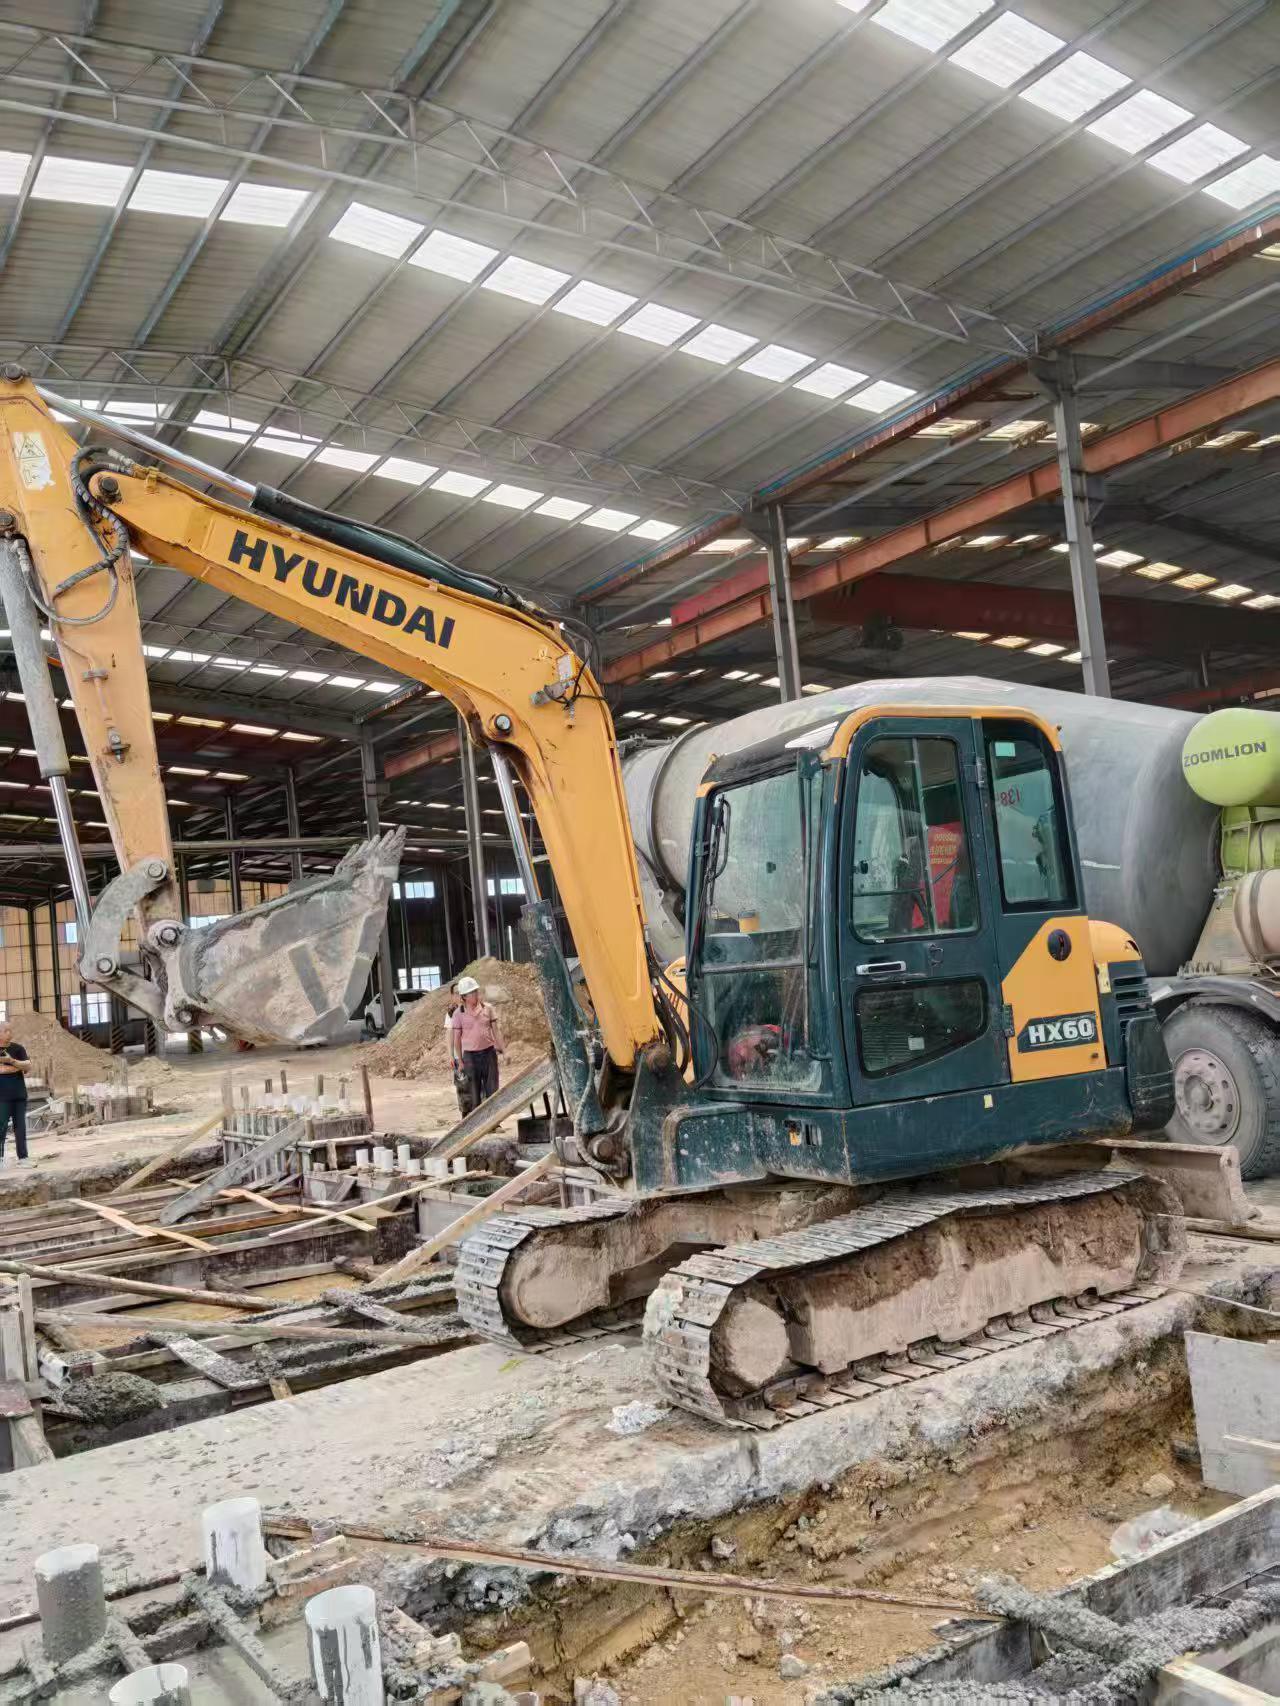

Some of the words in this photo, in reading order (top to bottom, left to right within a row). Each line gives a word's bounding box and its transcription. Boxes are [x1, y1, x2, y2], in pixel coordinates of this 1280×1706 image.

[228, 529, 456, 649] HYUNDAI
[1184, 741, 1267, 767] ZOOMLION
[1028, 1018, 1093, 1044] HX60
